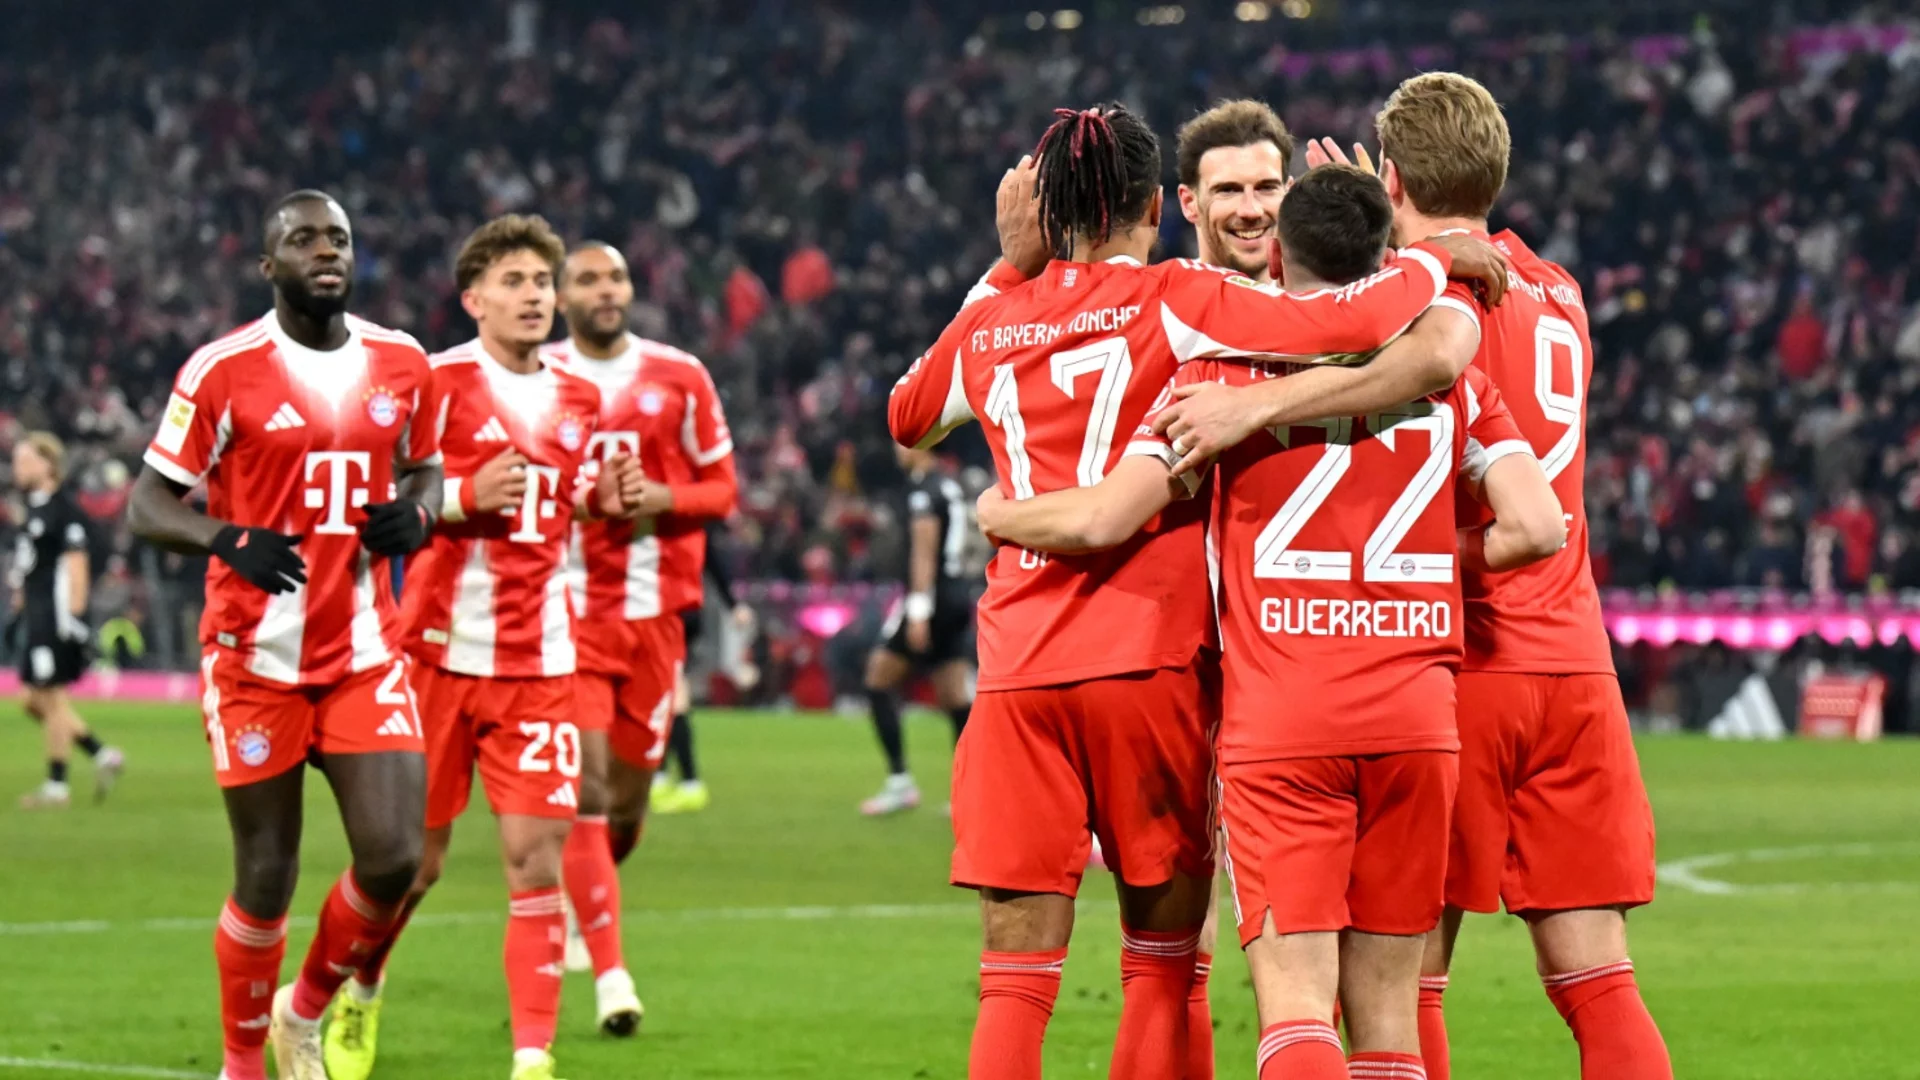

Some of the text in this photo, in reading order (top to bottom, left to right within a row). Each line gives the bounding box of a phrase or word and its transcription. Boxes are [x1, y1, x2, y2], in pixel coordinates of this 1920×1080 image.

[972, 330, 989, 353] FC
[993, 323, 1062, 349] BAYERN
[984, 336, 1133, 500] 17
[1534, 315, 1583, 484] 9
[1254, 402, 1454, 583] 22
[1260, 597, 1451, 637] GUERREIRO
[518, 720, 582, 778] 20
